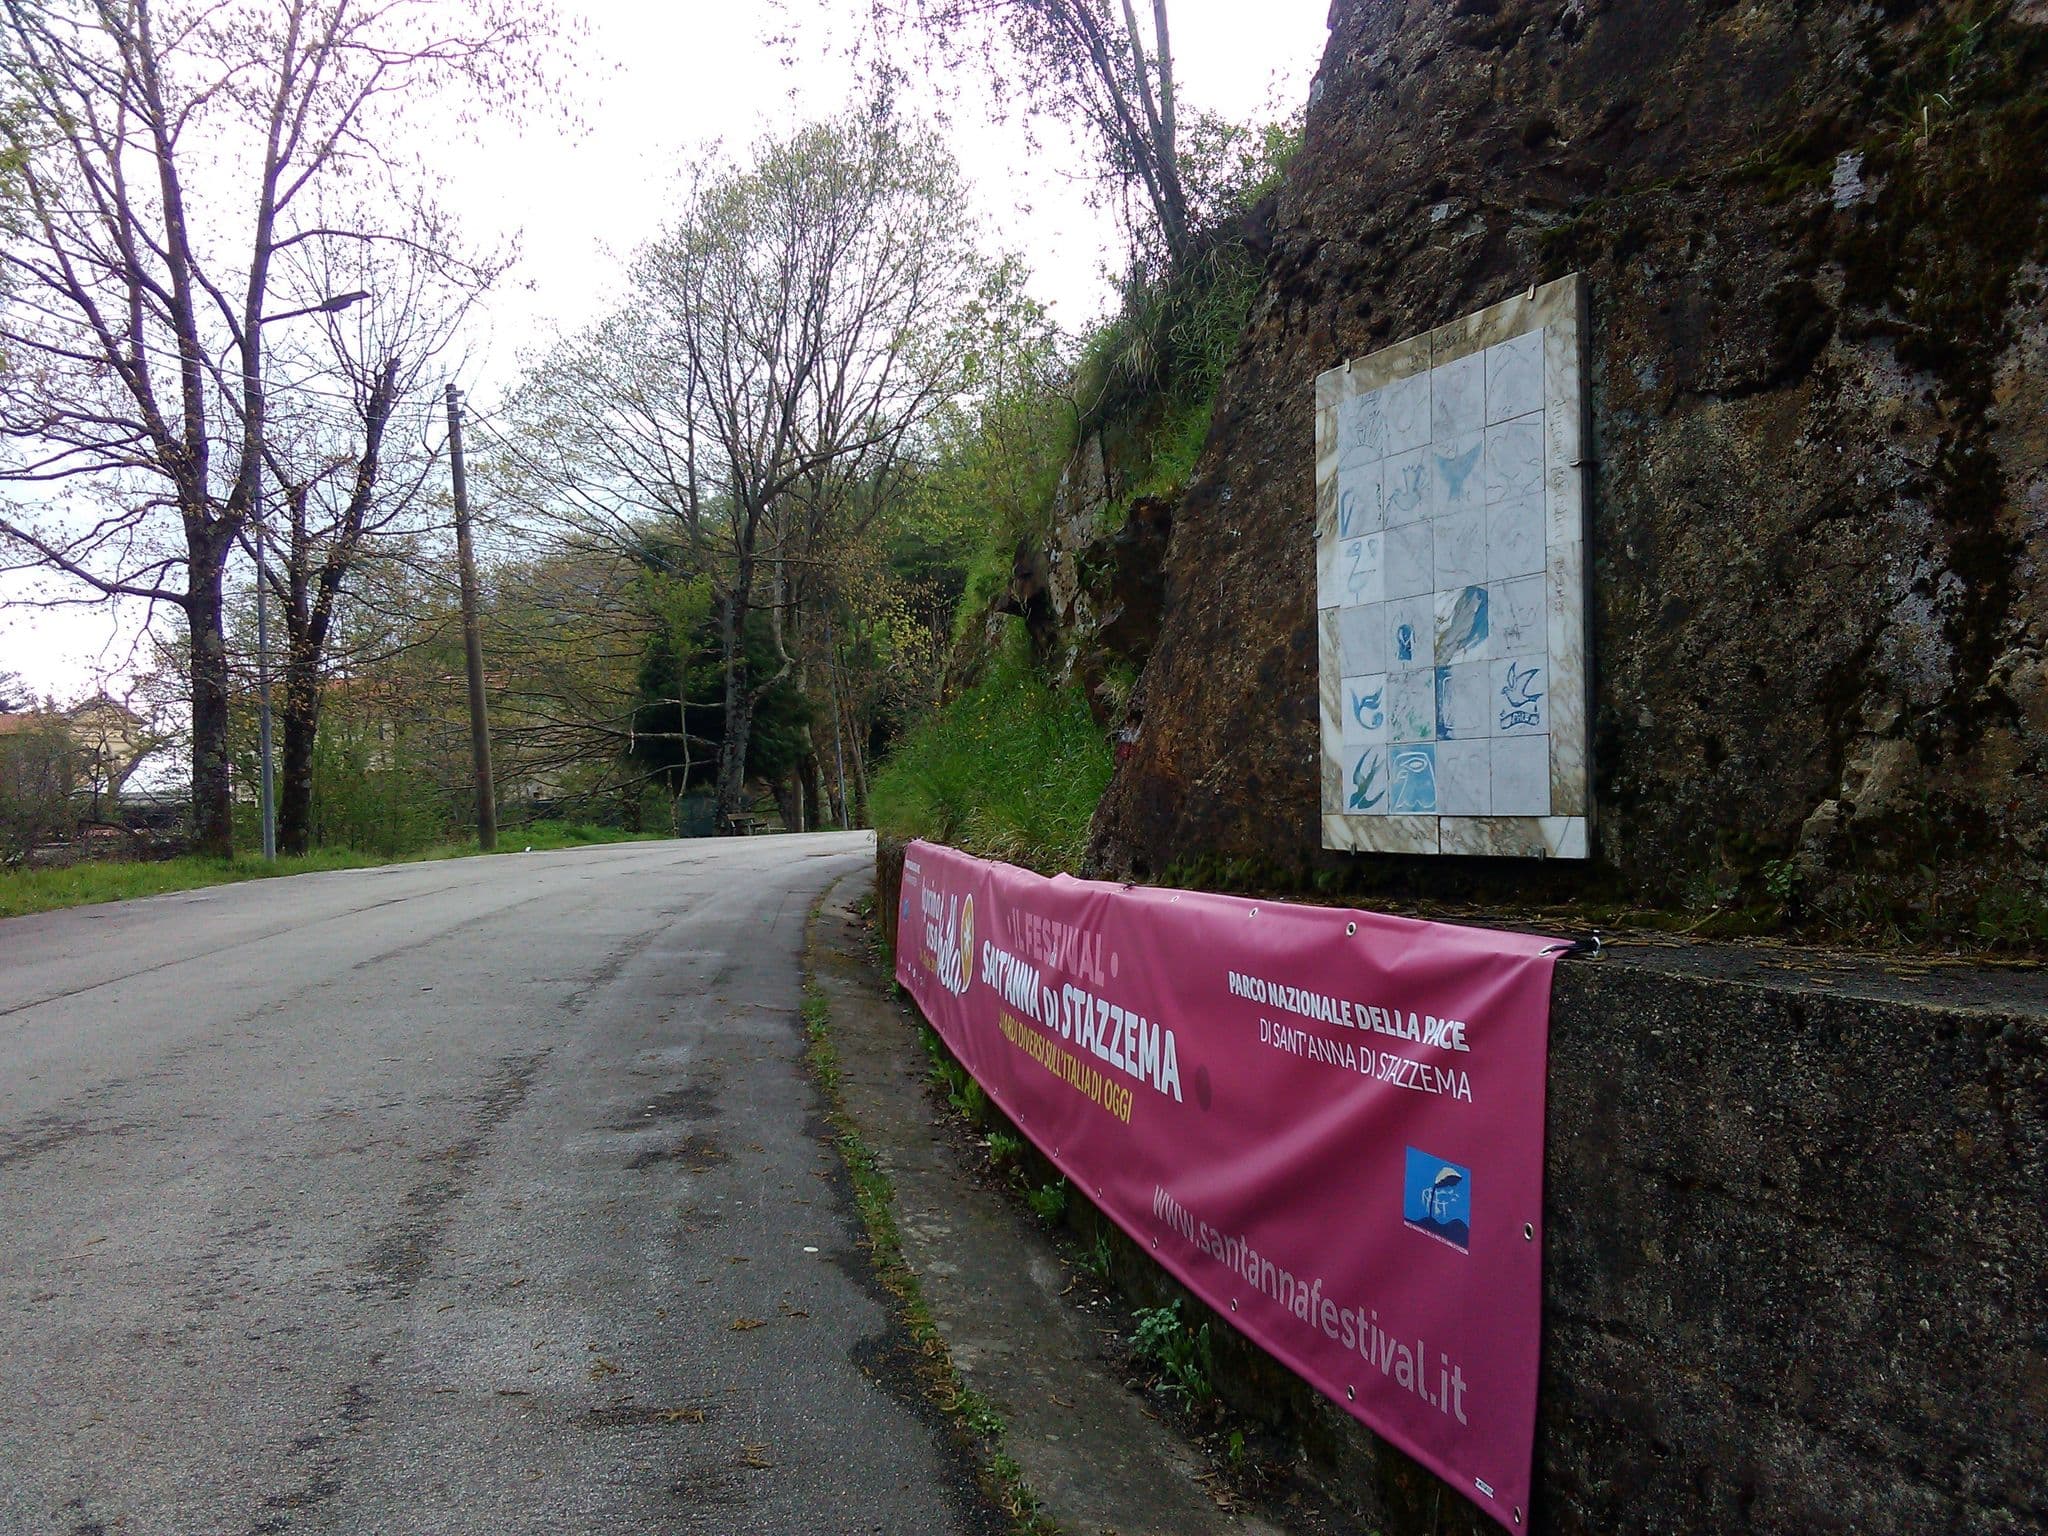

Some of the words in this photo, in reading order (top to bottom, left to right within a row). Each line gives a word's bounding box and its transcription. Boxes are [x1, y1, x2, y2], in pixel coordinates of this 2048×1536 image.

[1025, 912, 1105, 987] FESTIVAL
[1043, 986, 1060, 1032] DI
[1062, 983, 1183, 1103] STAZZEMA
[1228, 971, 1267, 1004] PARCO
[1268, 982, 1354, 1029] NAZIONALE
[1355, 1003, 1420, 1042] DELLA
[1422, 1014, 1471, 1052] PACE
[1018, 1022, 1046, 1063] DIVERSI
[1044, 1038, 1091, 1098] SULL'ITALIA
[1091, 1073, 1102, 1105] DI
[1104, 1078, 1133, 1124] OGGI
[1259, 1018, 1273, 1043] DI
[1273, 1023, 1357, 1072] SANT'ANNA
[1360, 1049, 1375, 1077] DI
[1379, 1051, 1473, 1103] STAZZEMA
[1152, 1184, 1469, 1426] www.santannafestival.it
